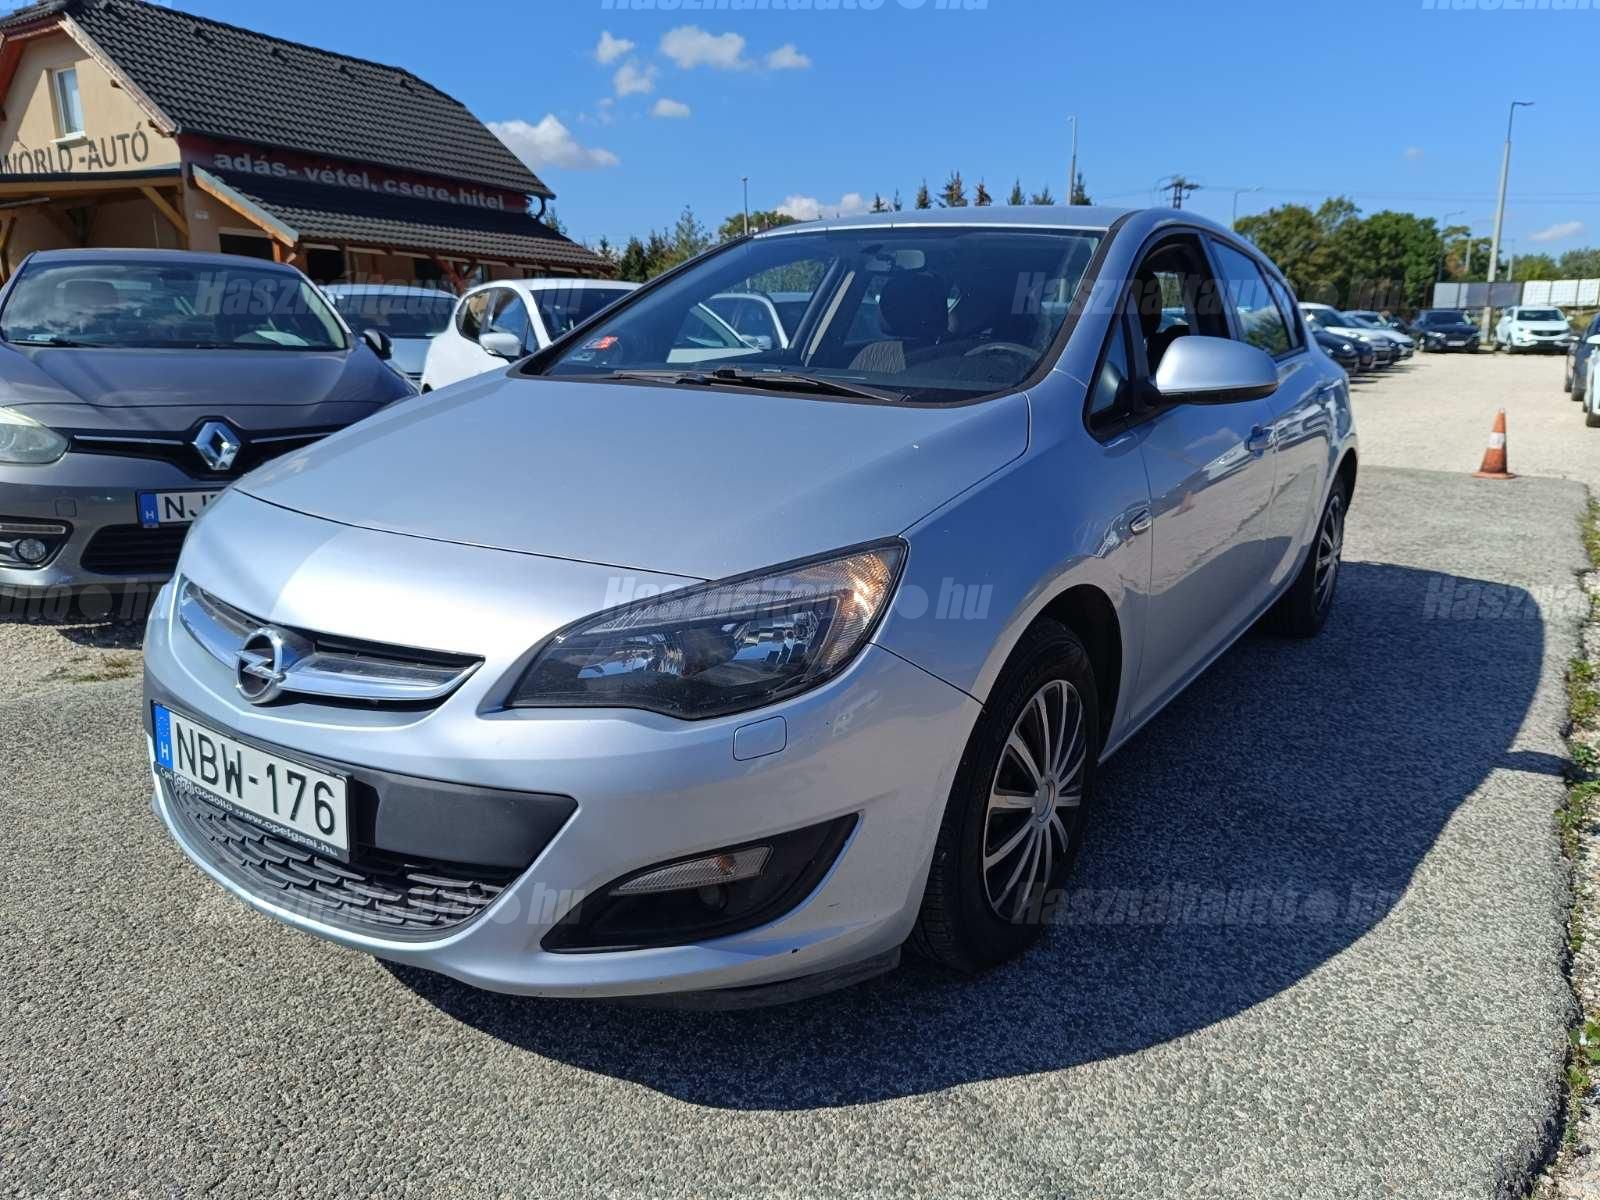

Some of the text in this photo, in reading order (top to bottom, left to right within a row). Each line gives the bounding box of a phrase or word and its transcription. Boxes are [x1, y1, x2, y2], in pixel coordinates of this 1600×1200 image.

[164, 495, 217, 520] NJ
[160, 742, 169, 760] H
[175, 721, 336, 837] NBW-176
